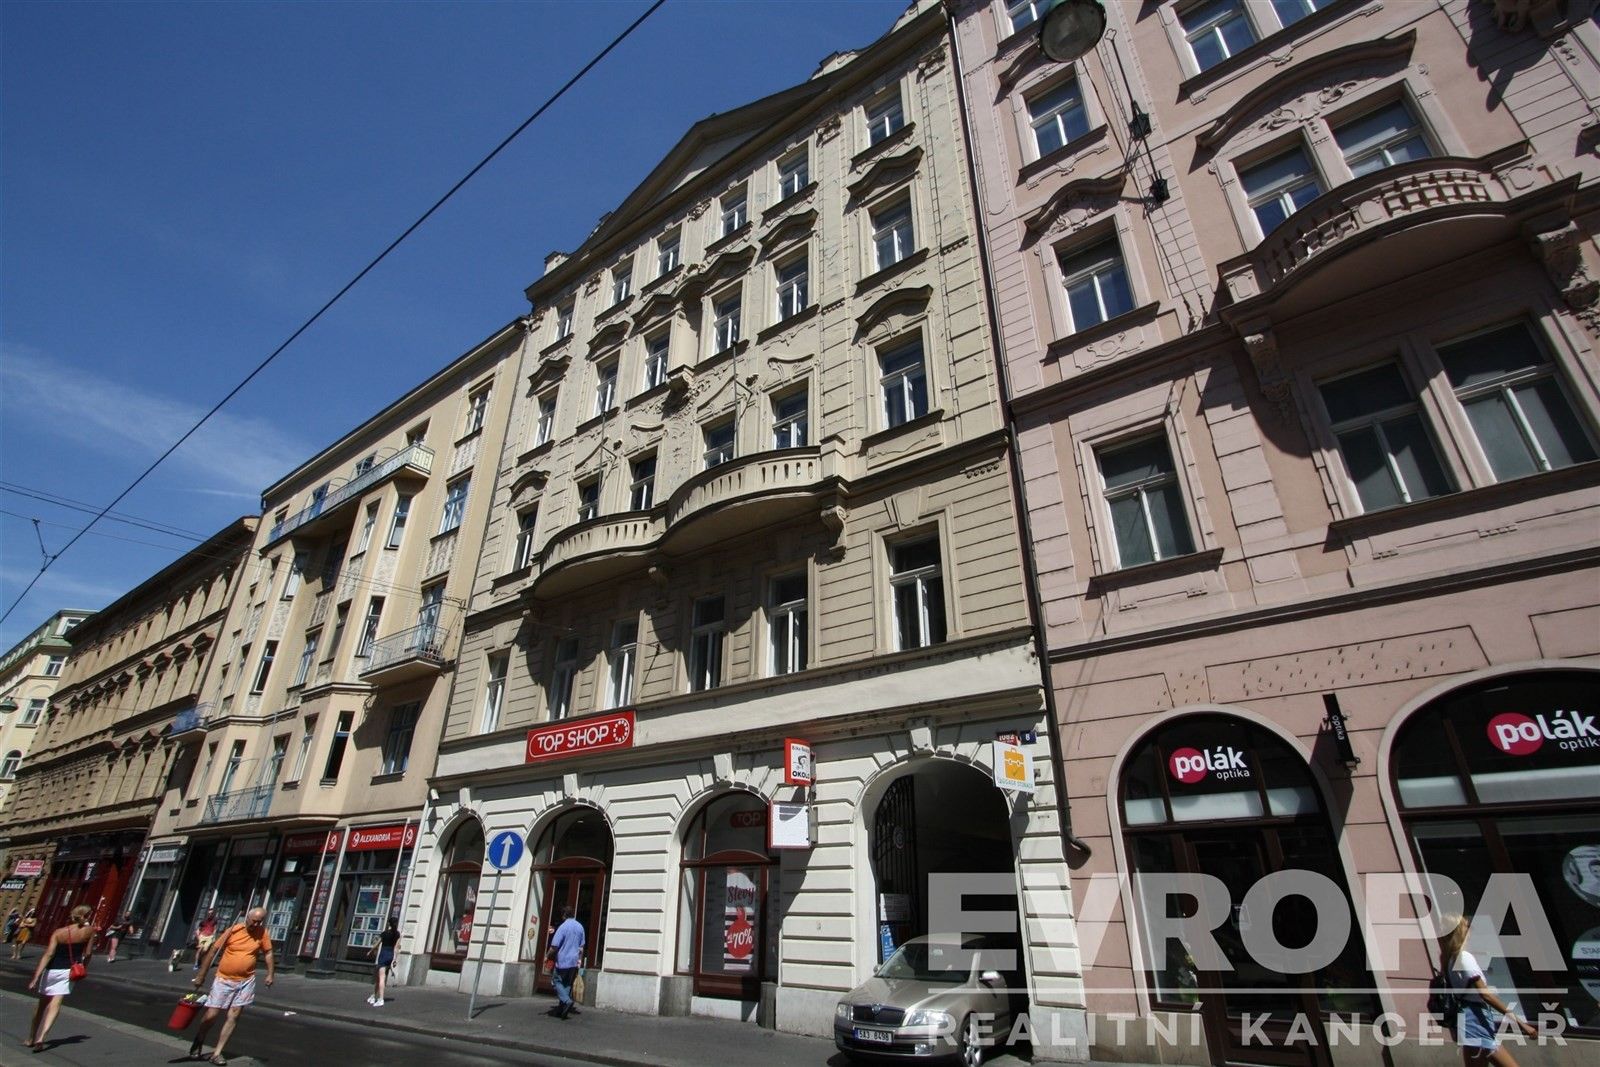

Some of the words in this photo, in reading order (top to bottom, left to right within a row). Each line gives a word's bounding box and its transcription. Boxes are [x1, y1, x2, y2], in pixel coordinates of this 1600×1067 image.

[1331, 714, 1345, 740] optika
[1495, 710, 1600, 750] polák
[538, 733, 564, 752] TOP
[567, 725, 609, 748] SHOP
[1559, 737, 1600, 752] optik
[1175, 746, 1247, 779] polák
[1216, 769, 1250, 781] optika
[736, 812, 761, 826] TOP
[360, 833, 391, 843] ALEXANDRIA
[733, 928, 753, 949] 70%
